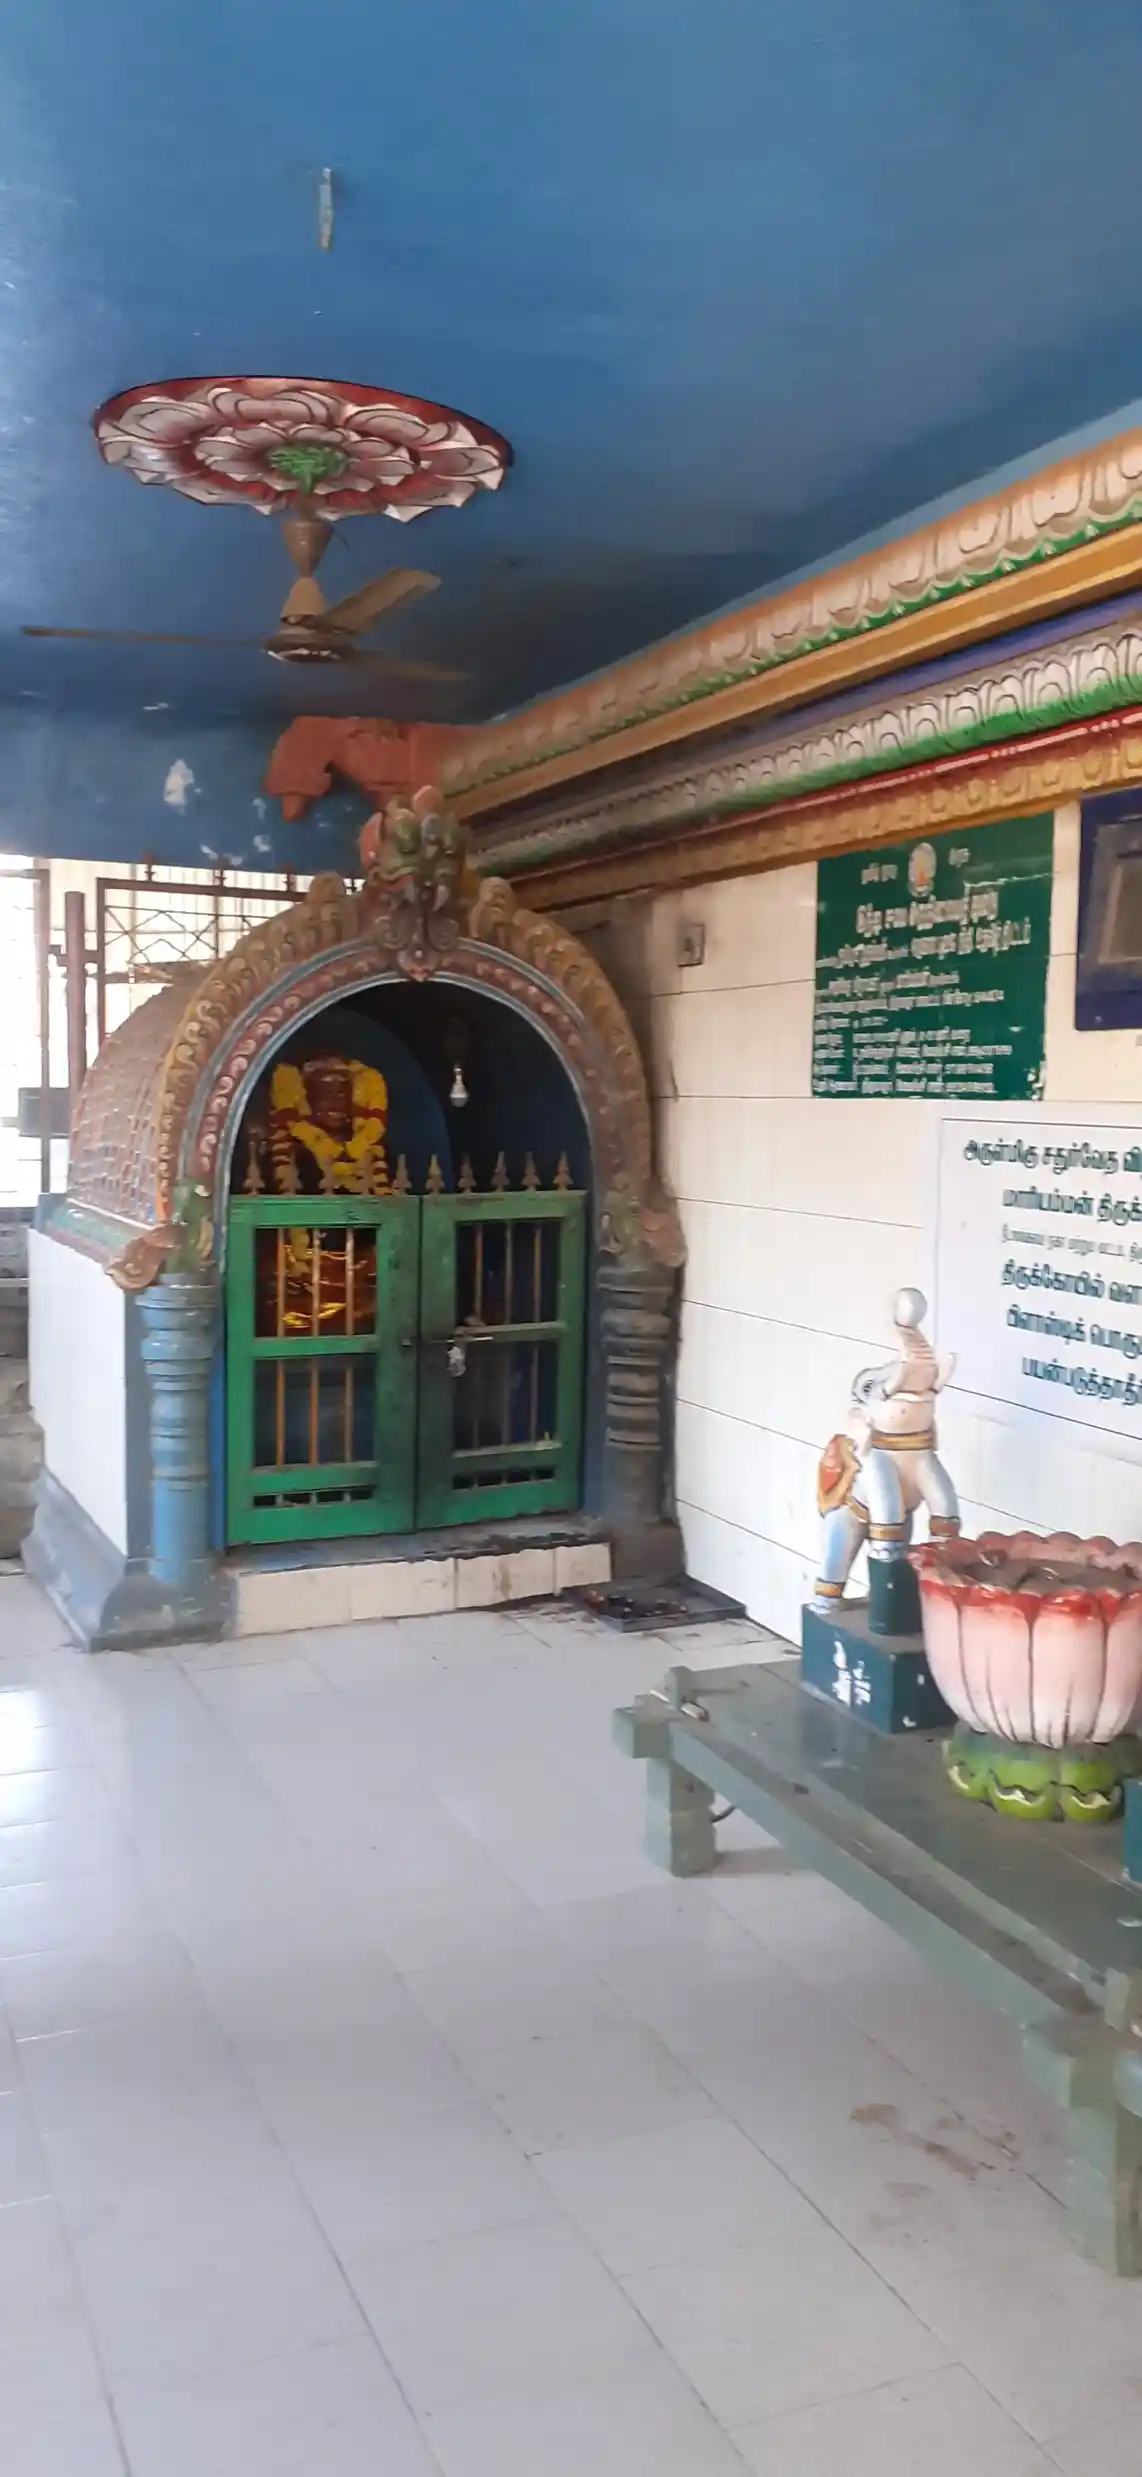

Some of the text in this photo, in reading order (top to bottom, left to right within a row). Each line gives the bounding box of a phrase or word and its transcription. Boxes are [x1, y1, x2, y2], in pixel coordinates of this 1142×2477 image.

[963, 1138, 1142, 1179] அருள்மிகு சதுர்வேத வி
[1002, 1185, 1095, 1215] மாரியம்மன்
[1001, 1259, 1106, 1298] திருக்கோயில்
[1006, 1304, 1086, 1345] பிளாஸ்டிக்
